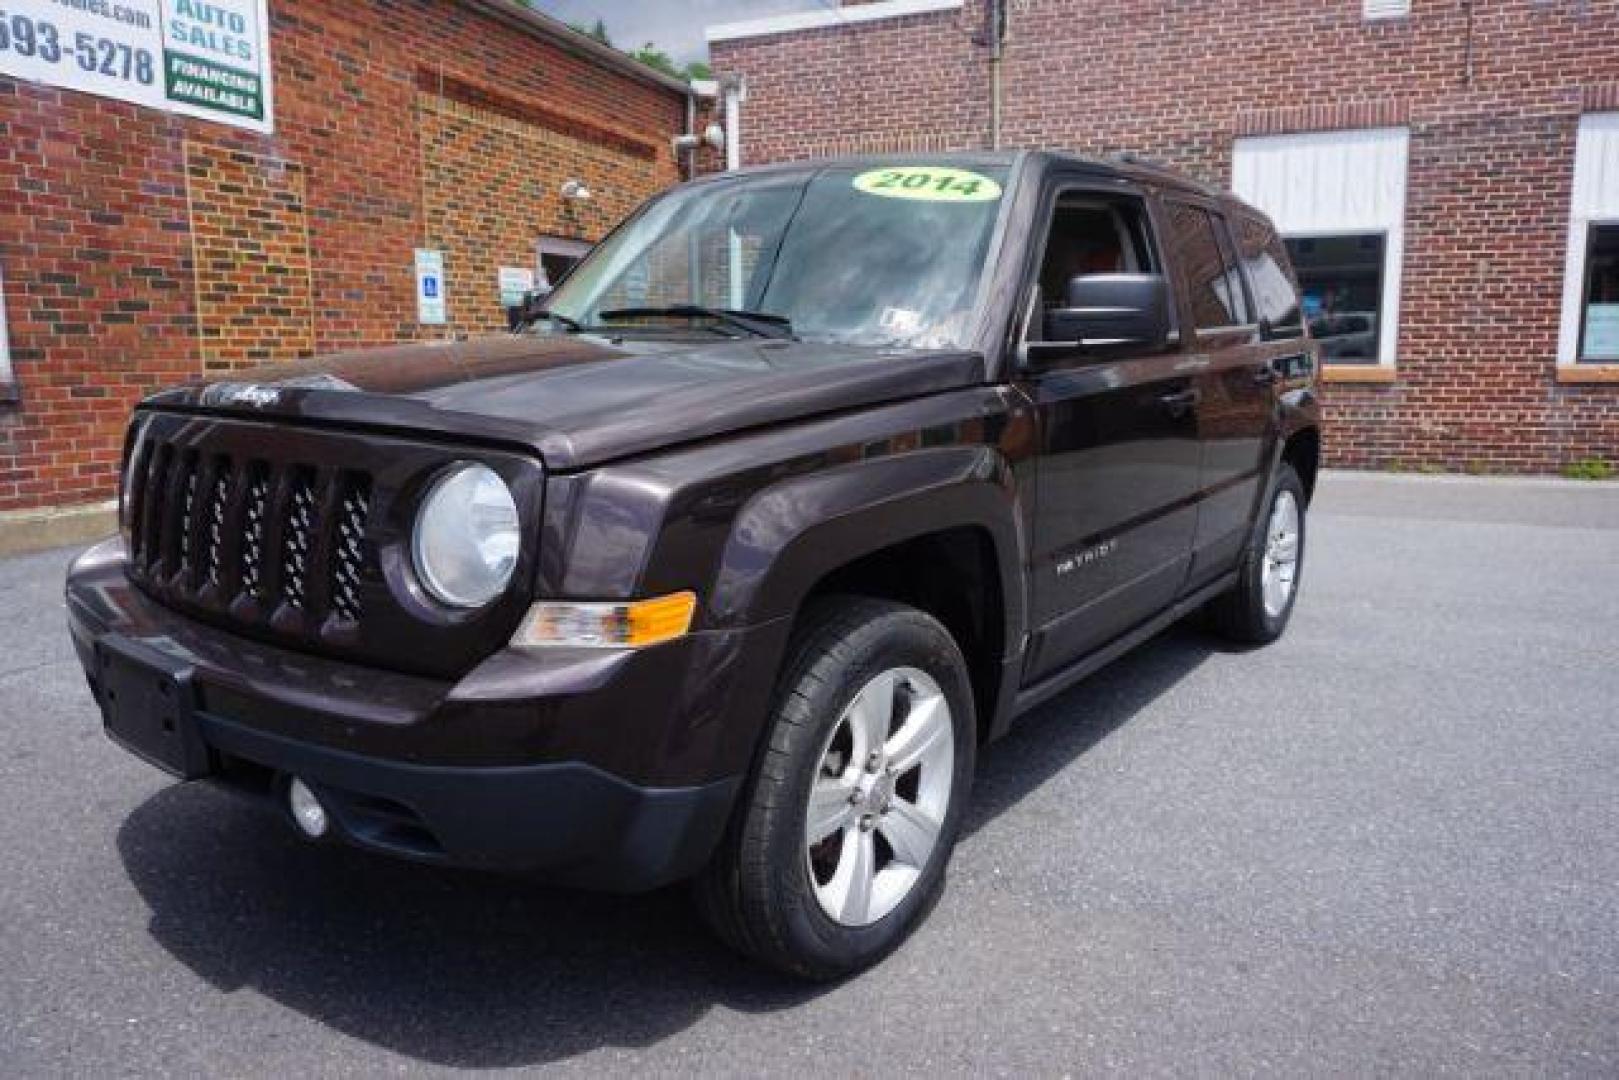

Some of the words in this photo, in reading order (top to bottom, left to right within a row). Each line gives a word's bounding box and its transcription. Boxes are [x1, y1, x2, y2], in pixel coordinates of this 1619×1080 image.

[56, 0, 152, 28] ales.com
[176, 0, 244, 33] AUTO
[172, 20, 251, 60] SALES
[171, 57, 257, 93] FINANCING
[172, 80, 257, 112] AVAILABLE
[871, 171, 982, 196] 2014
